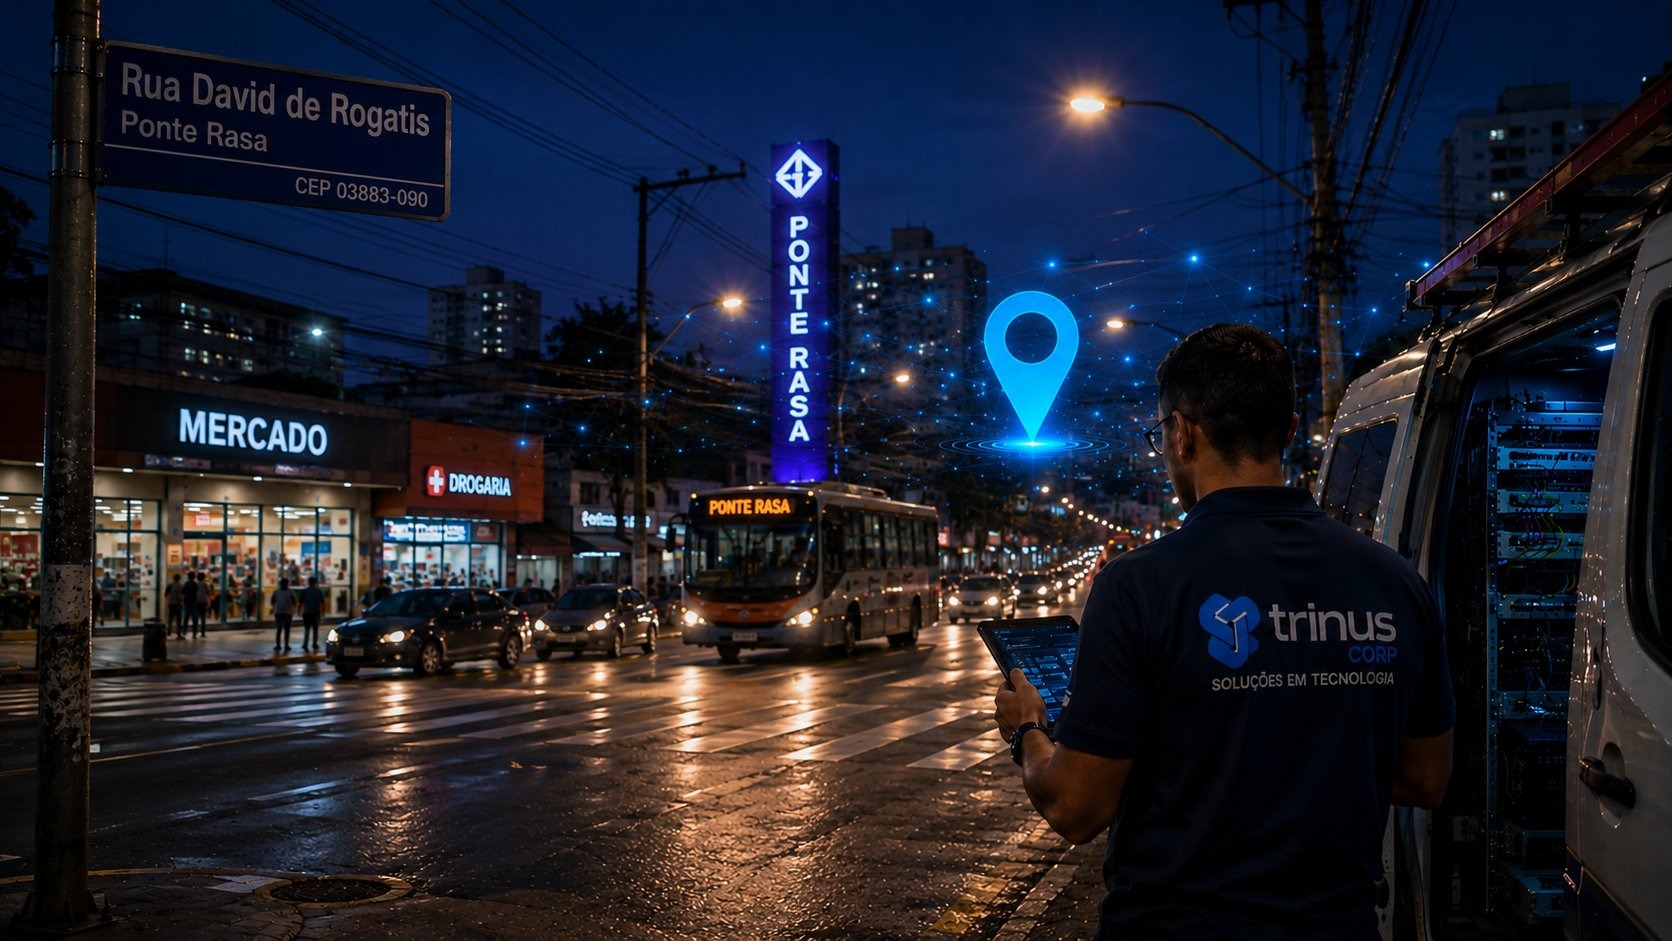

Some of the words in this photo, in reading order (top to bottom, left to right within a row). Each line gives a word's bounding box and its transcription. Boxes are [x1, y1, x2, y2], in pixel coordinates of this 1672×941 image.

[121, 62, 181, 103] Rua
[192, 72, 276, 117] David
[286, 87, 321, 121] de
[330, 91, 431, 139] Rogatis
[121, 110, 198, 144] Ponte
[206, 122, 269, 153] Rasa
[295, 176, 332, 197] CEP
[336, 181, 429, 209] 03883-090
[788, 216, 810, 335] PONTE
[788, 347, 810, 442] RASA
[179, 408, 328, 457] MERCADO
[448, 472, 512, 497] DROGARIA
[708, 498, 753, 516] PONTE
[754, 498, 791, 515] RASA
[1268, 602, 1397, 642] trinus
[1348, 645, 1398, 664] CORP
[1211, 671, 1283, 692] SOLUÇÕES
[1287, 673, 1307, 687] EM
[1311, 671, 1395, 686] TECNOLOGIA
